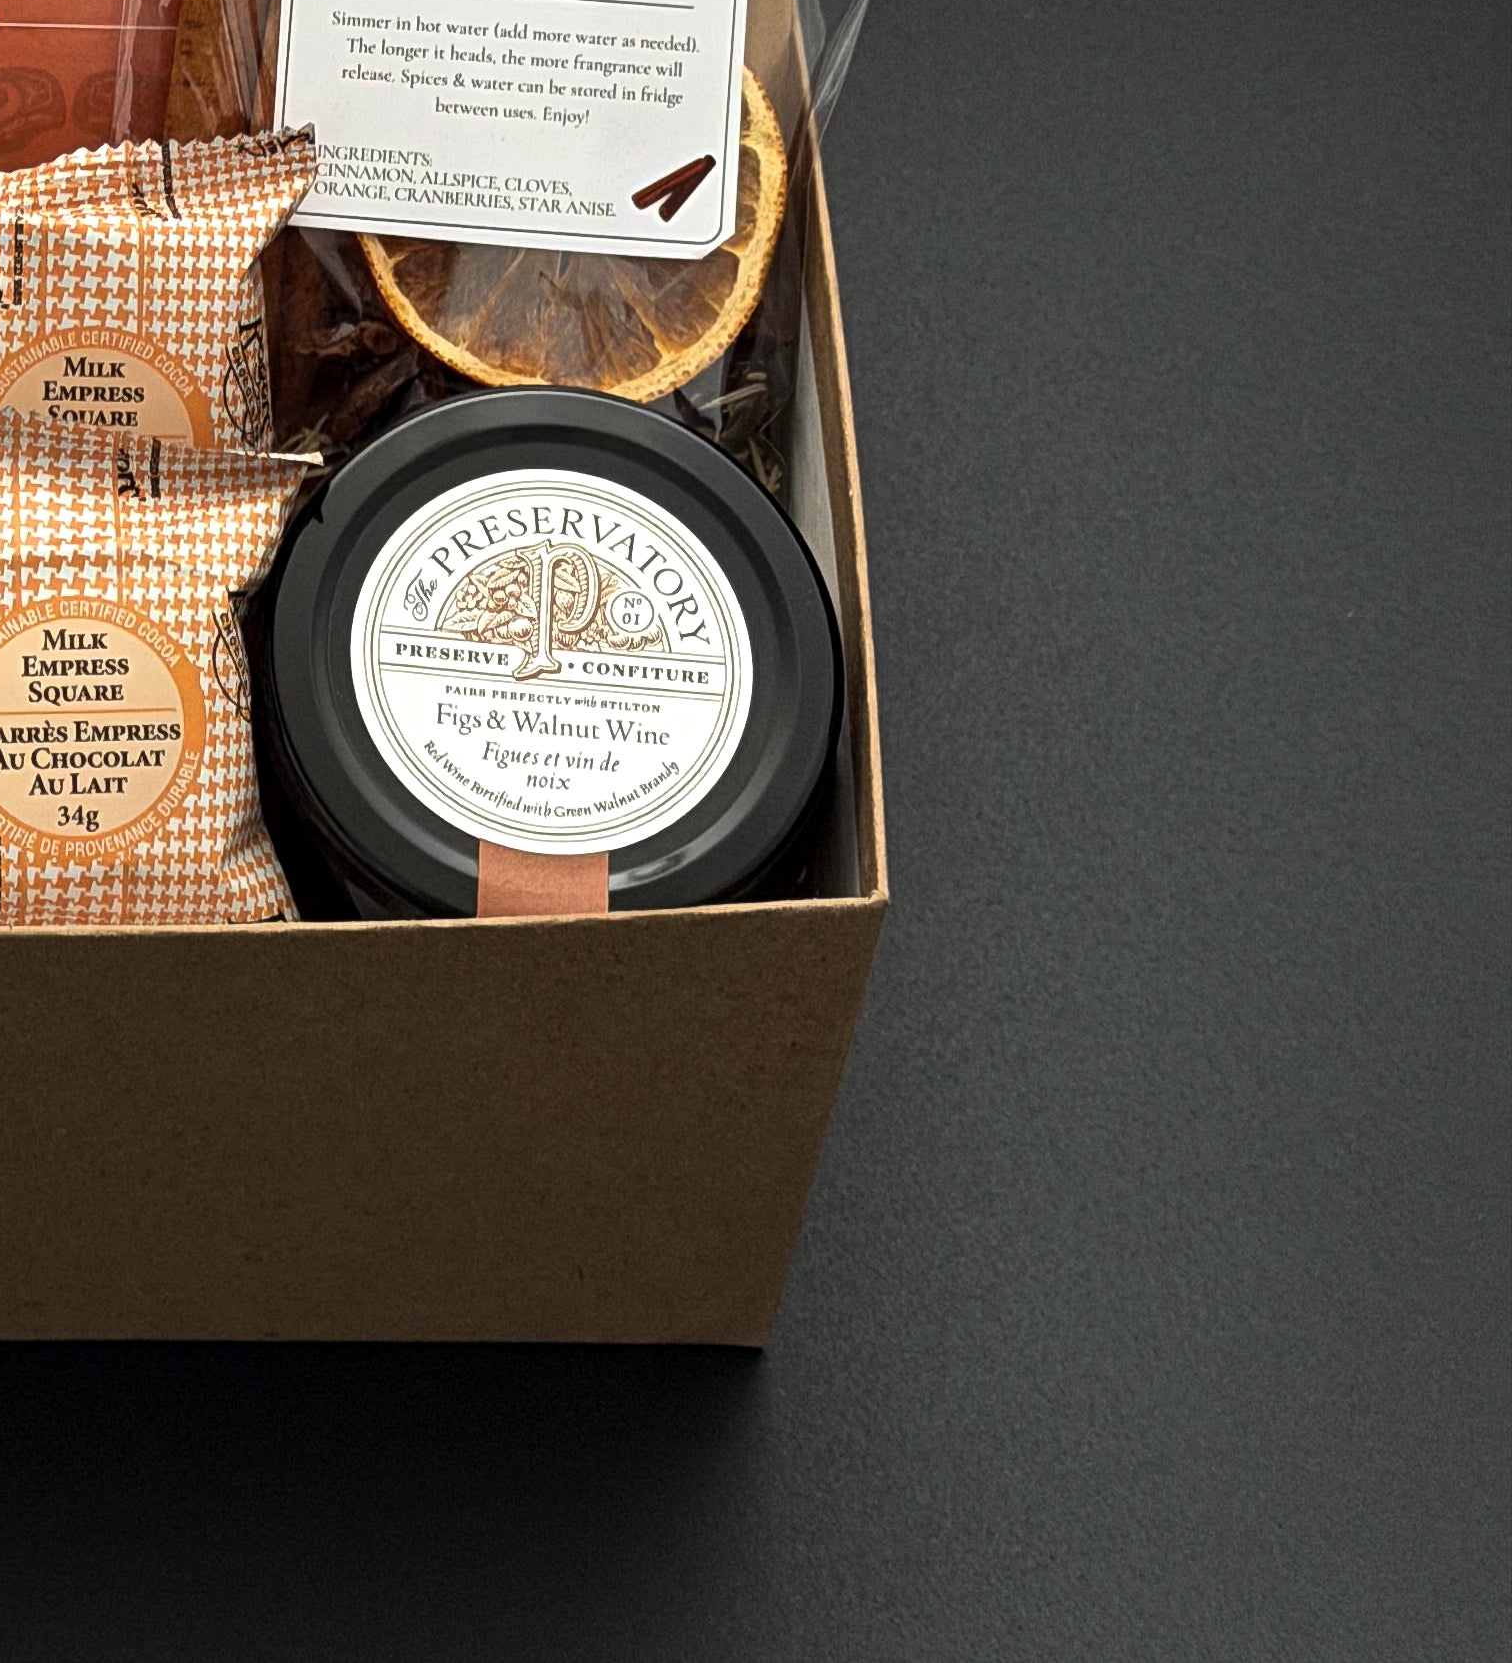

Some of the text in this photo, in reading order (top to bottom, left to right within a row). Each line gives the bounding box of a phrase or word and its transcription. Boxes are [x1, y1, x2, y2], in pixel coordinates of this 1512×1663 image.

[331, 10, 700, 53] Simmer in hot water (add more water as needed).
[346, 37, 376, 54] The
[381, 38, 429, 62] longer
[434, 45, 445, 60] it
[501, 49, 526, 66] the
[530, 56, 569, 69] more
[656, 61, 683, 78] will
[341, 64, 684, 109] release. Spices & water can be stored in fridge
[435, 96, 590, 129] between uses. Enjoy!
[317, 144, 432, 168] INGREDIENTS:
[316, 162, 573, 197] CINNAMON, ALLSPICE, CLOVES,
[314, 180, 391, 202] ORANGE,
[394, 187, 515, 211] CRANBERRIES,
[518, 196, 562, 214] STAR
[63, 356, 126, 378] MILK
[81, 331, 154, 360] CERTIFIED
[154, 354, 194, 399] COCOA
[42, 380, 145, 403] EMPRESS
[403, 506, 710, 645] The PRESERVATORY
[42, 629, 108, 651] MILK
[60, 600, 137, 629] CERTIFIED
[138, 622, 181, 668] COCOA
[21, 655, 129, 678] EMPRESS
[395, 643, 709, 684] PRESERVE CONFITURE
[28, 681, 124, 706] SQUARE
[445, 685, 661, 713] PAIRS PERFECTLY with STILTON
[74, 721, 181, 743] EMPRESS
[437, 702, 670, 746] Figs & Walnut Wine
[31, 747, 165, 770] CHOCOLAT
[482, 741, 620, 772] Figues et vin de
[28, 772, 128, 796] AU LAIT
[424, 740, 680, 818] Red Wine Fortified with Green Walnut Brandy
[527, 772, 571, 790] noix
[40, 838, 60, 857] DE
[65, 811, 162, 857] PROVENANCE
[157, 750, 200, 818] DURABLE
[57, 805, 100, 832] 34g
